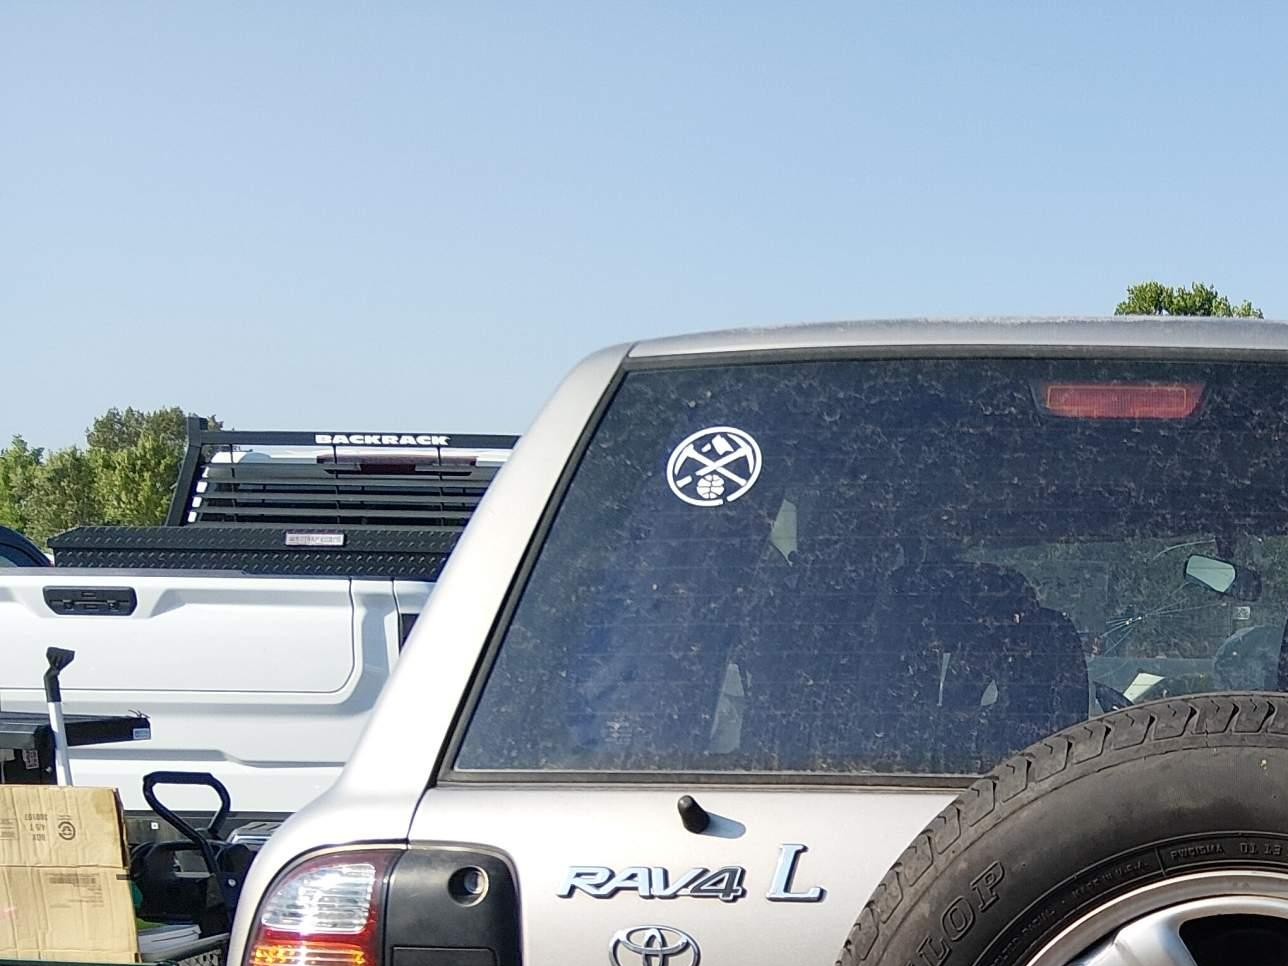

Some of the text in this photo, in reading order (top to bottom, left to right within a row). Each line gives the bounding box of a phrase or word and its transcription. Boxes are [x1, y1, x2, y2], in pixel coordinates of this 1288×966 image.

[314, 434, 449, 446] BACKRACK
[557, 843, 826, 902] RAV4 L
